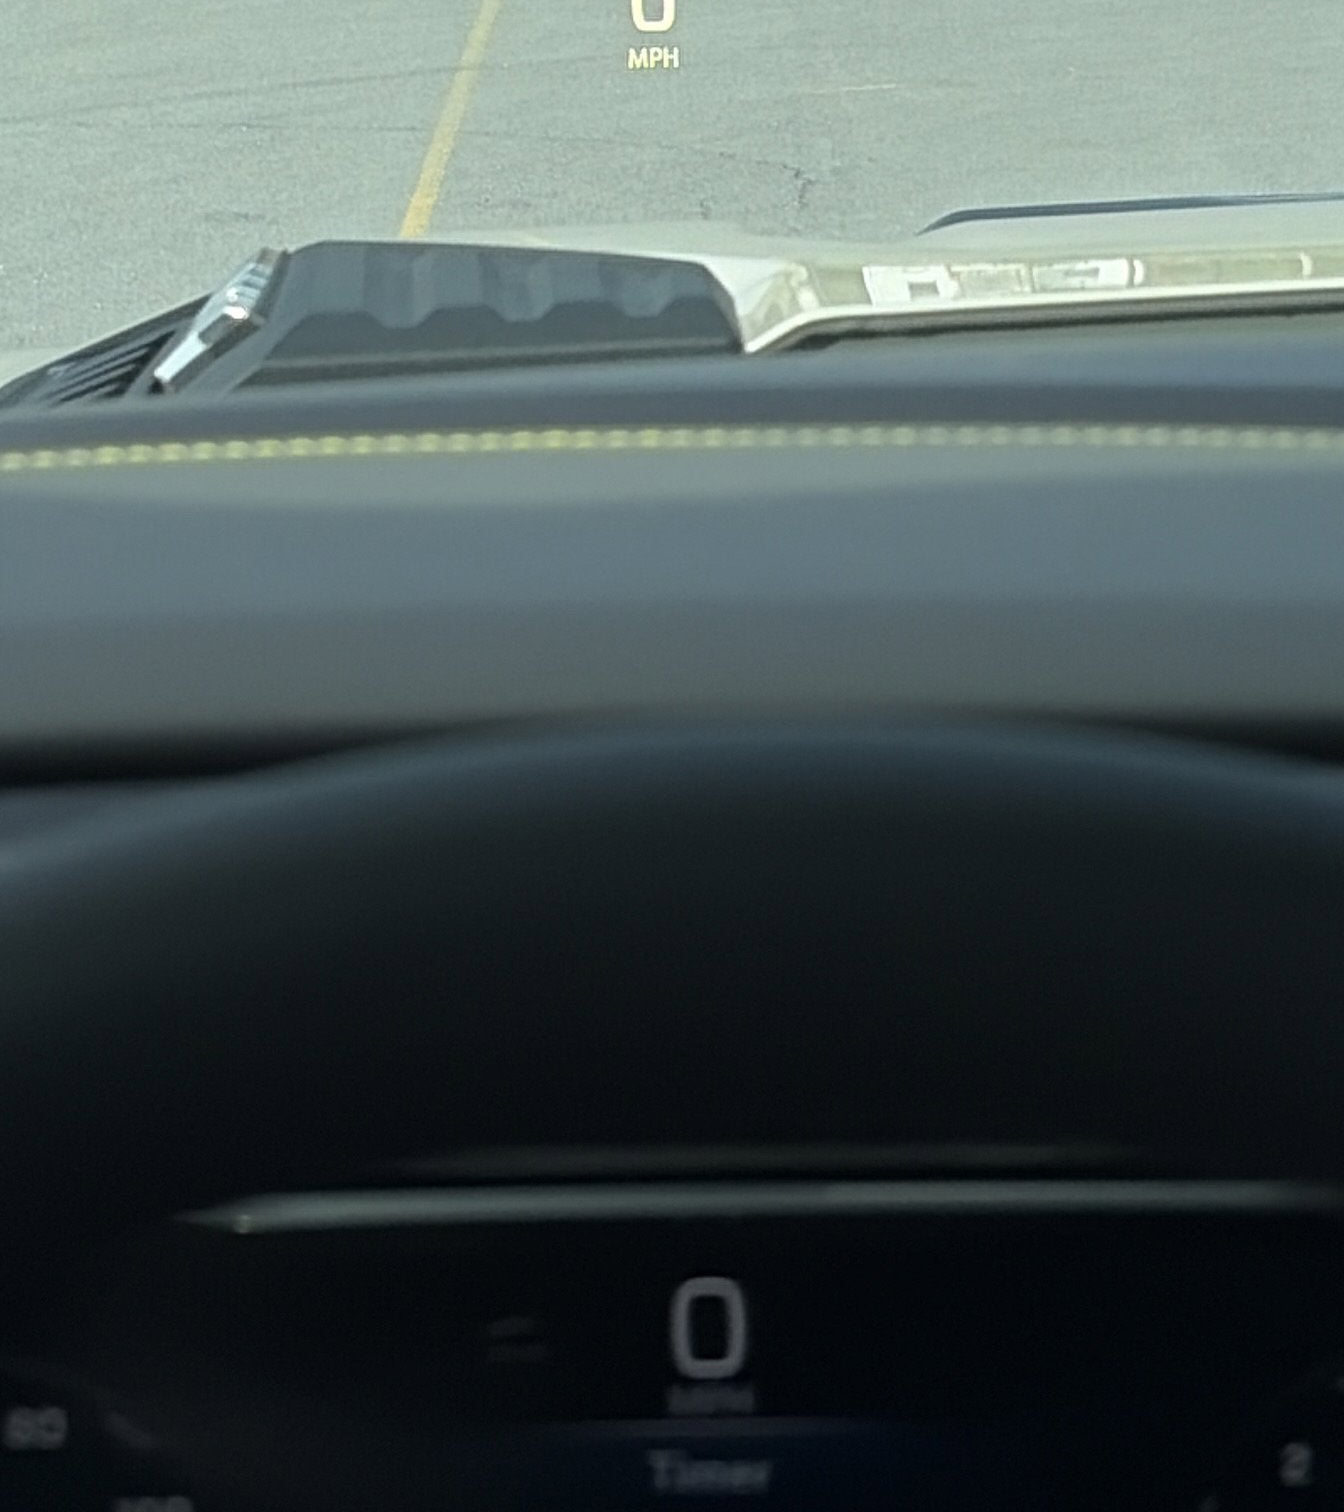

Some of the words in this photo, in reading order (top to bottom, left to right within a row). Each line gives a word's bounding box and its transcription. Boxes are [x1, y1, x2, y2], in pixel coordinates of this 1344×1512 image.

[627, 46, 681, 69] MPH
[669, 1275, 747, 1380] 0
[1278, 1441, 1314, 1487] 2
